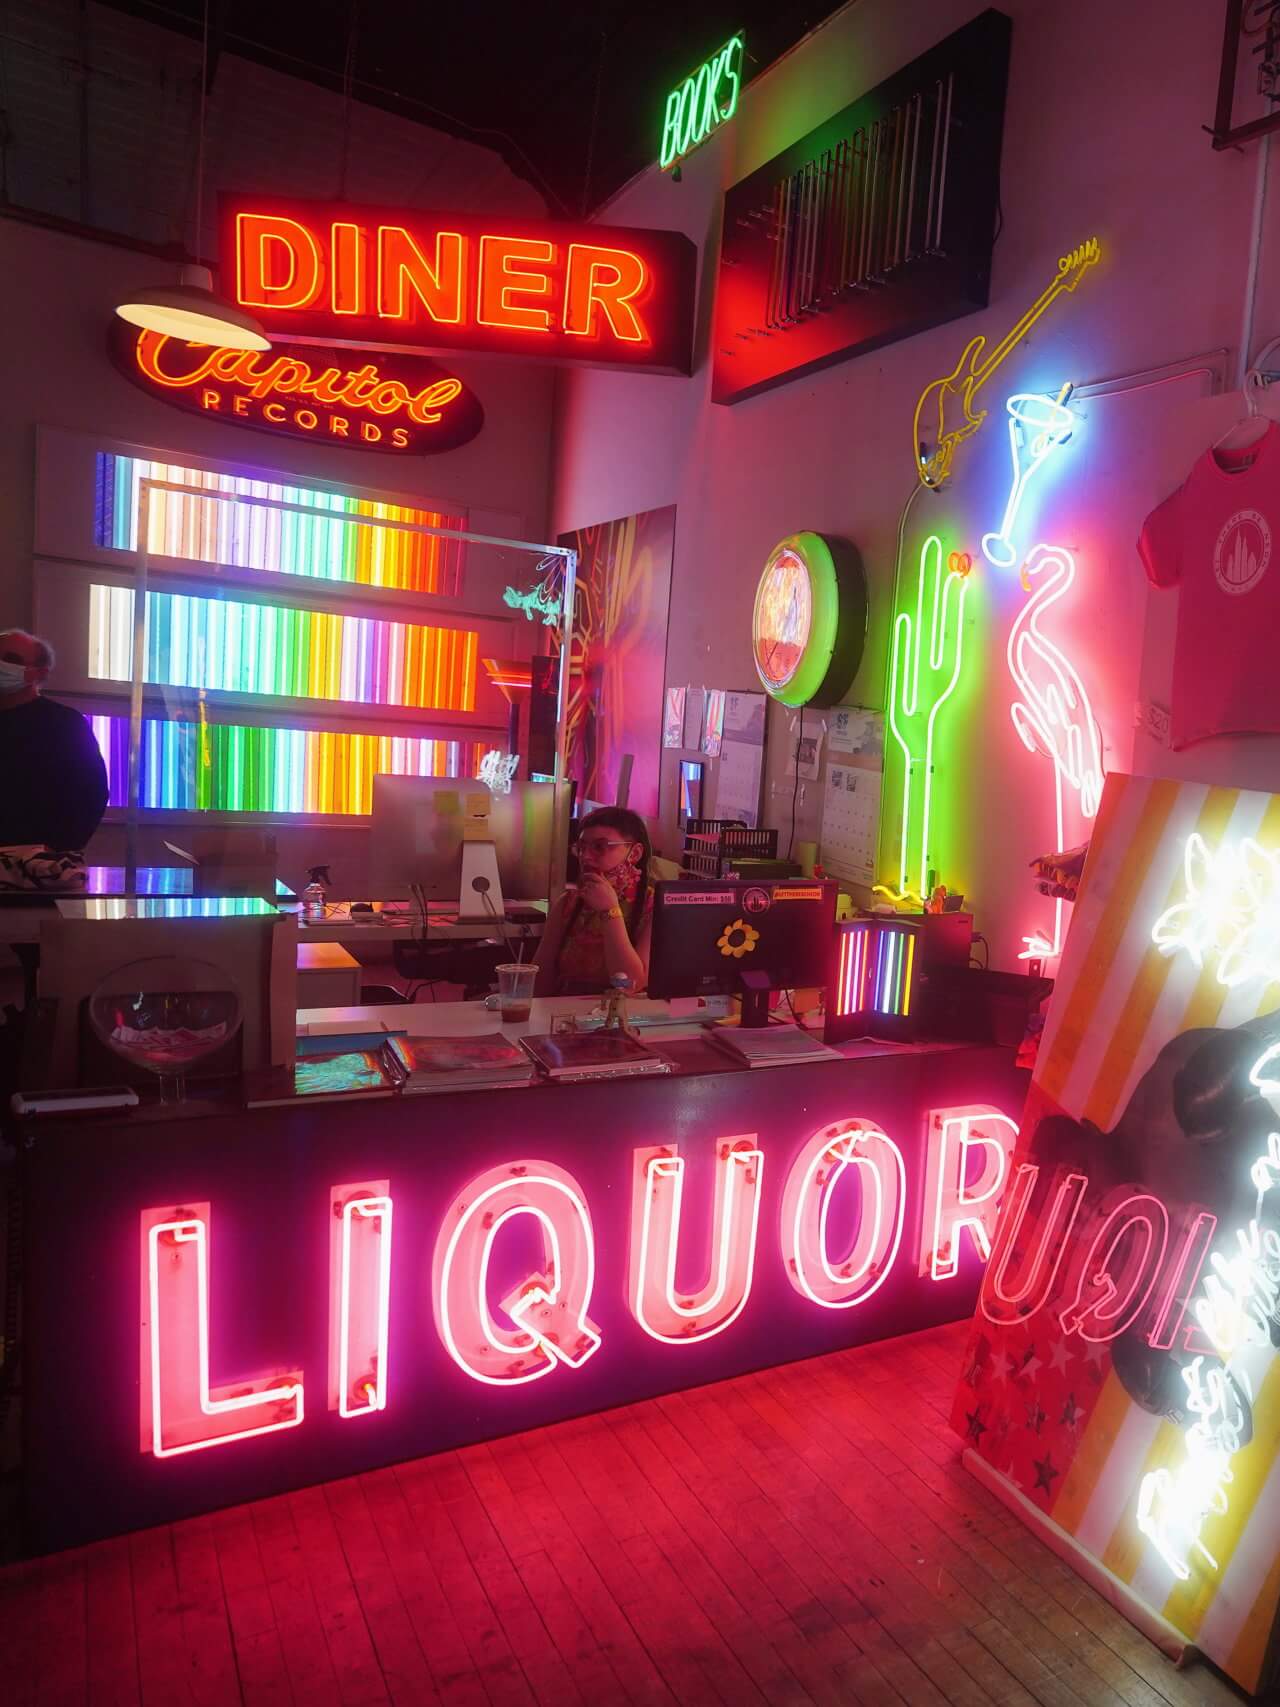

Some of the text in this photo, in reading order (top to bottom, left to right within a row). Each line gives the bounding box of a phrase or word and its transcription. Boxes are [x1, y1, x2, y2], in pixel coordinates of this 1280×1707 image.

[660, 37, 742, 168] BOOKS
[236, 212, 652, 343] DINER
[136, 327, 462, 424] Capitol
[202, 387, 411, 448] RECORDS
[139, 1104, 1020, 1459] LIQUOR
